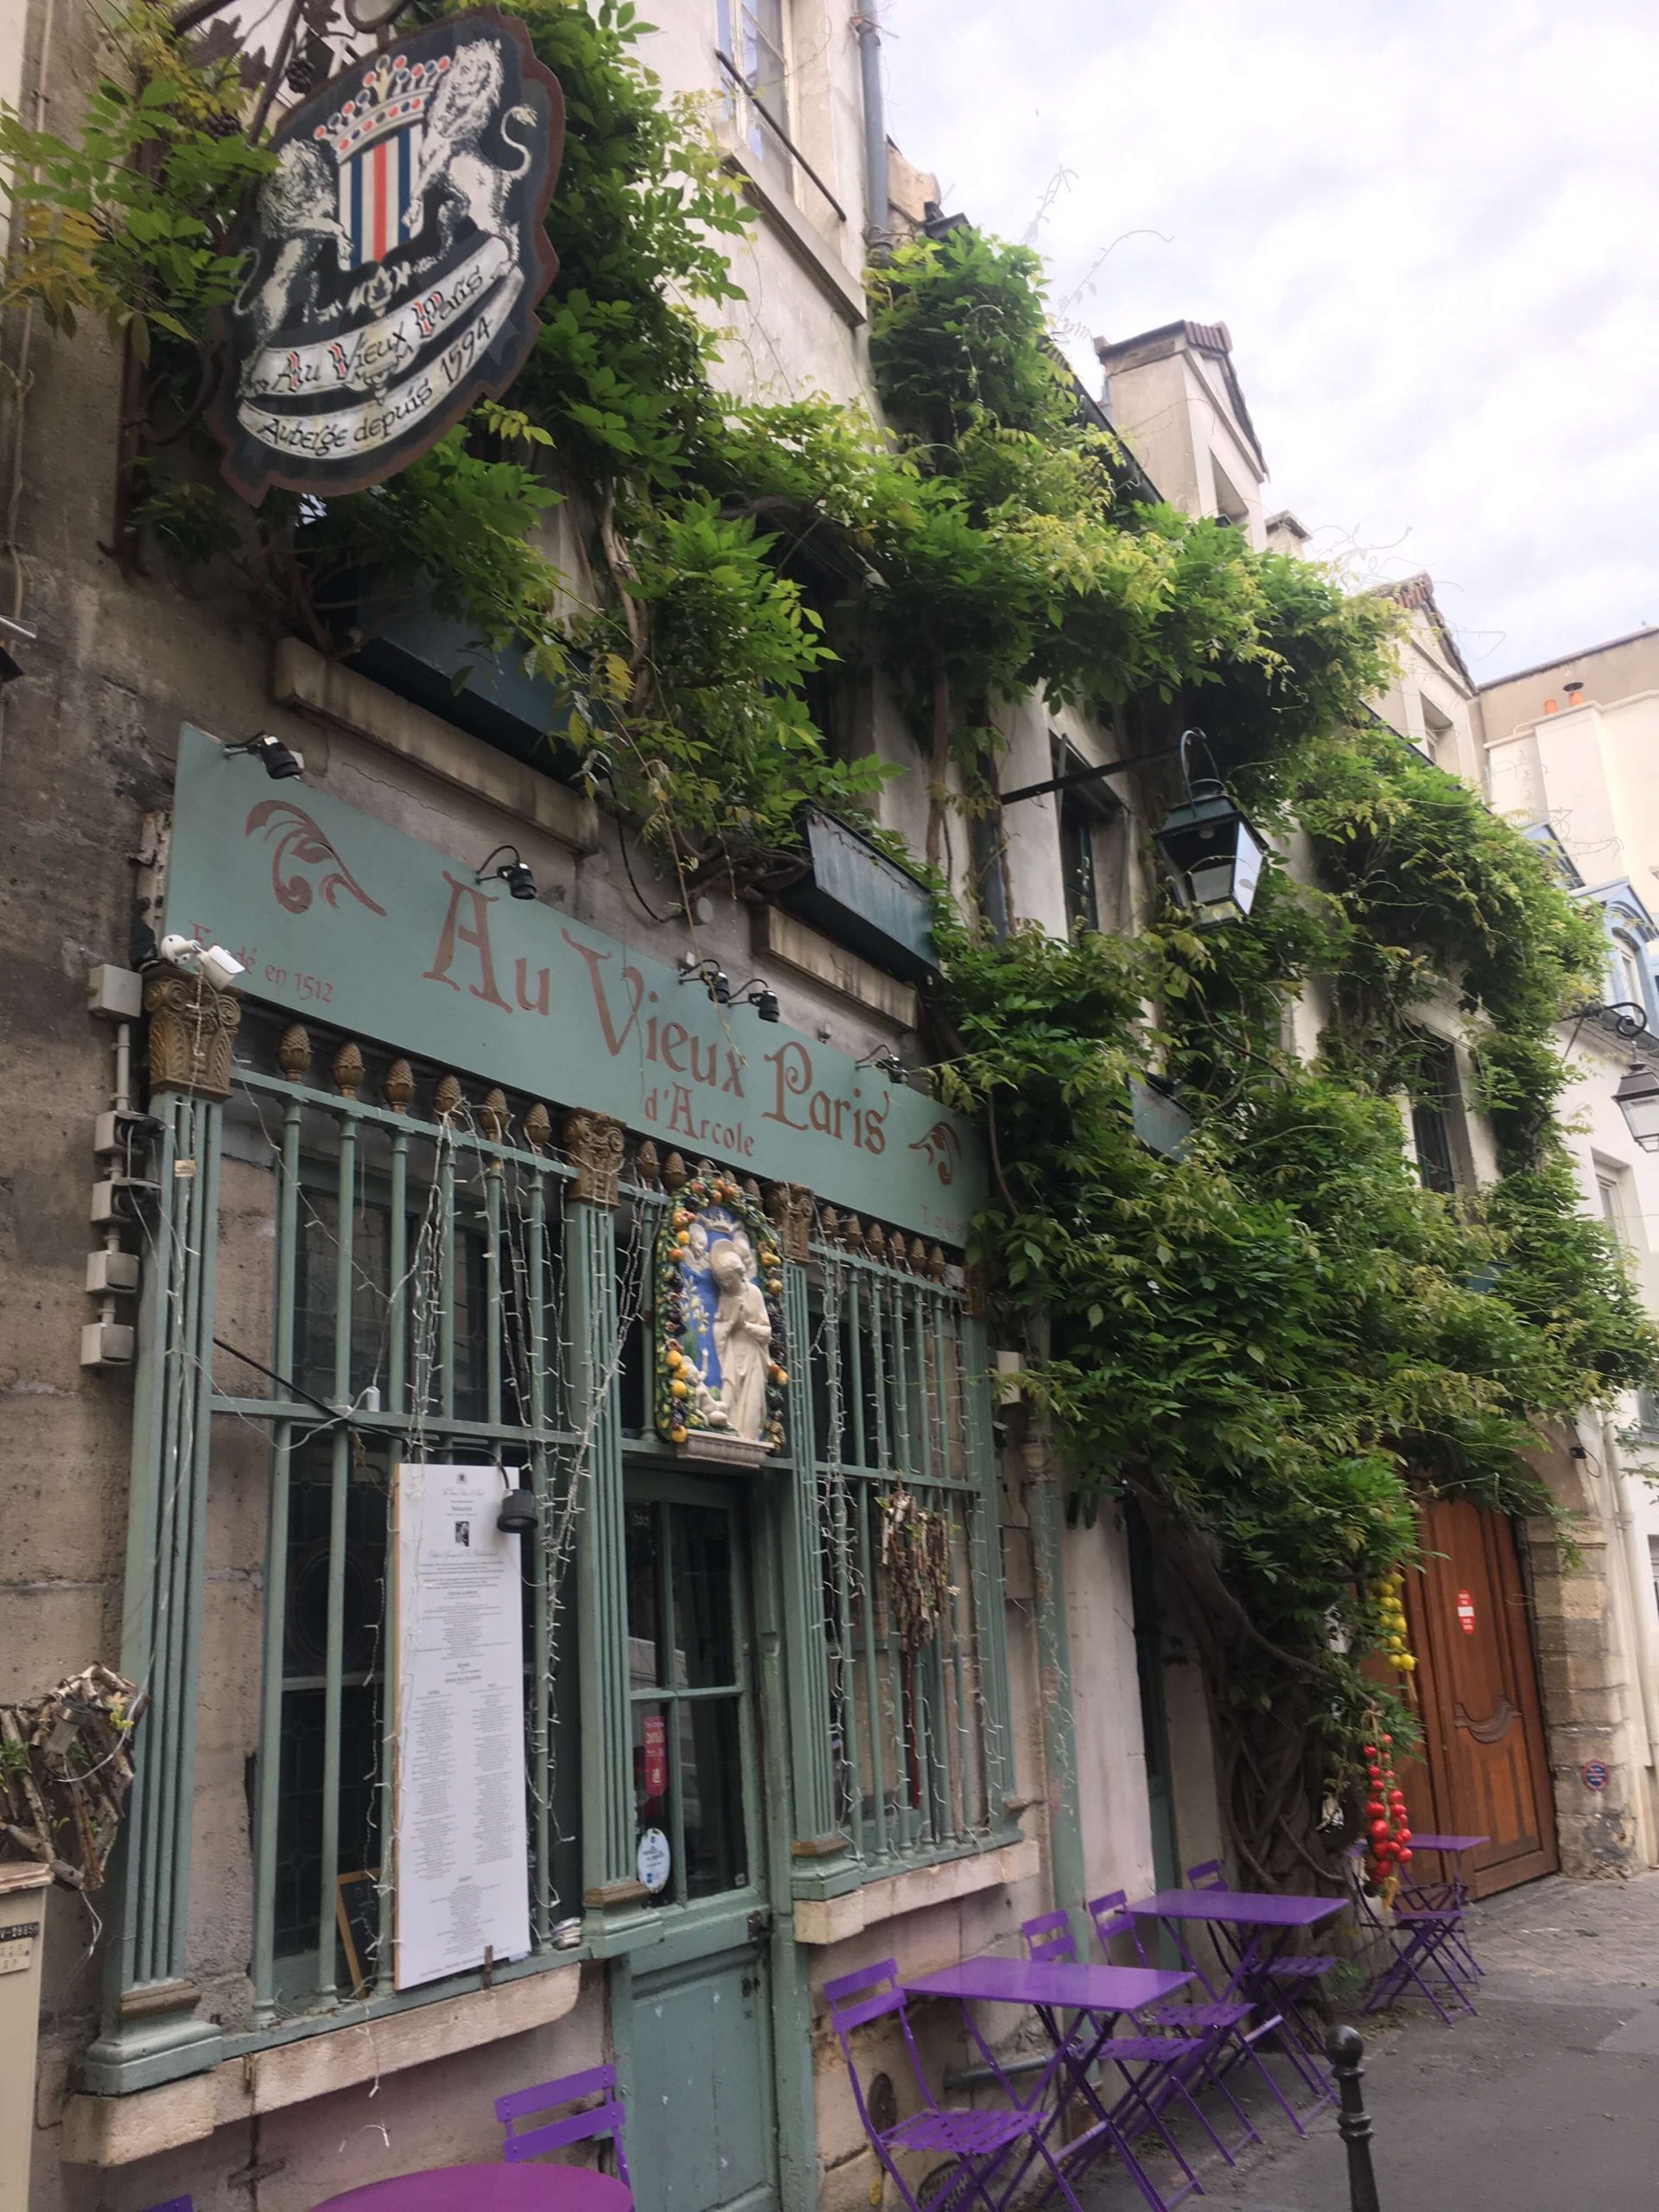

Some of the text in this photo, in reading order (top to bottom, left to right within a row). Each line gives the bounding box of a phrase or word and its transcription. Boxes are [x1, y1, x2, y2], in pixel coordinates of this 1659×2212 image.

[257, 315, 493, 456] Auberge depuis 1594
[273, 265, 482, 392] Au Vieux Paris
[189, 919, 257, 975] Fdé
[295, 973, 333, 1003] 1512
[422, 870, 890, 1154] Au Vieux Paris
[645, 1082, 754, 1156] d'Arcole
